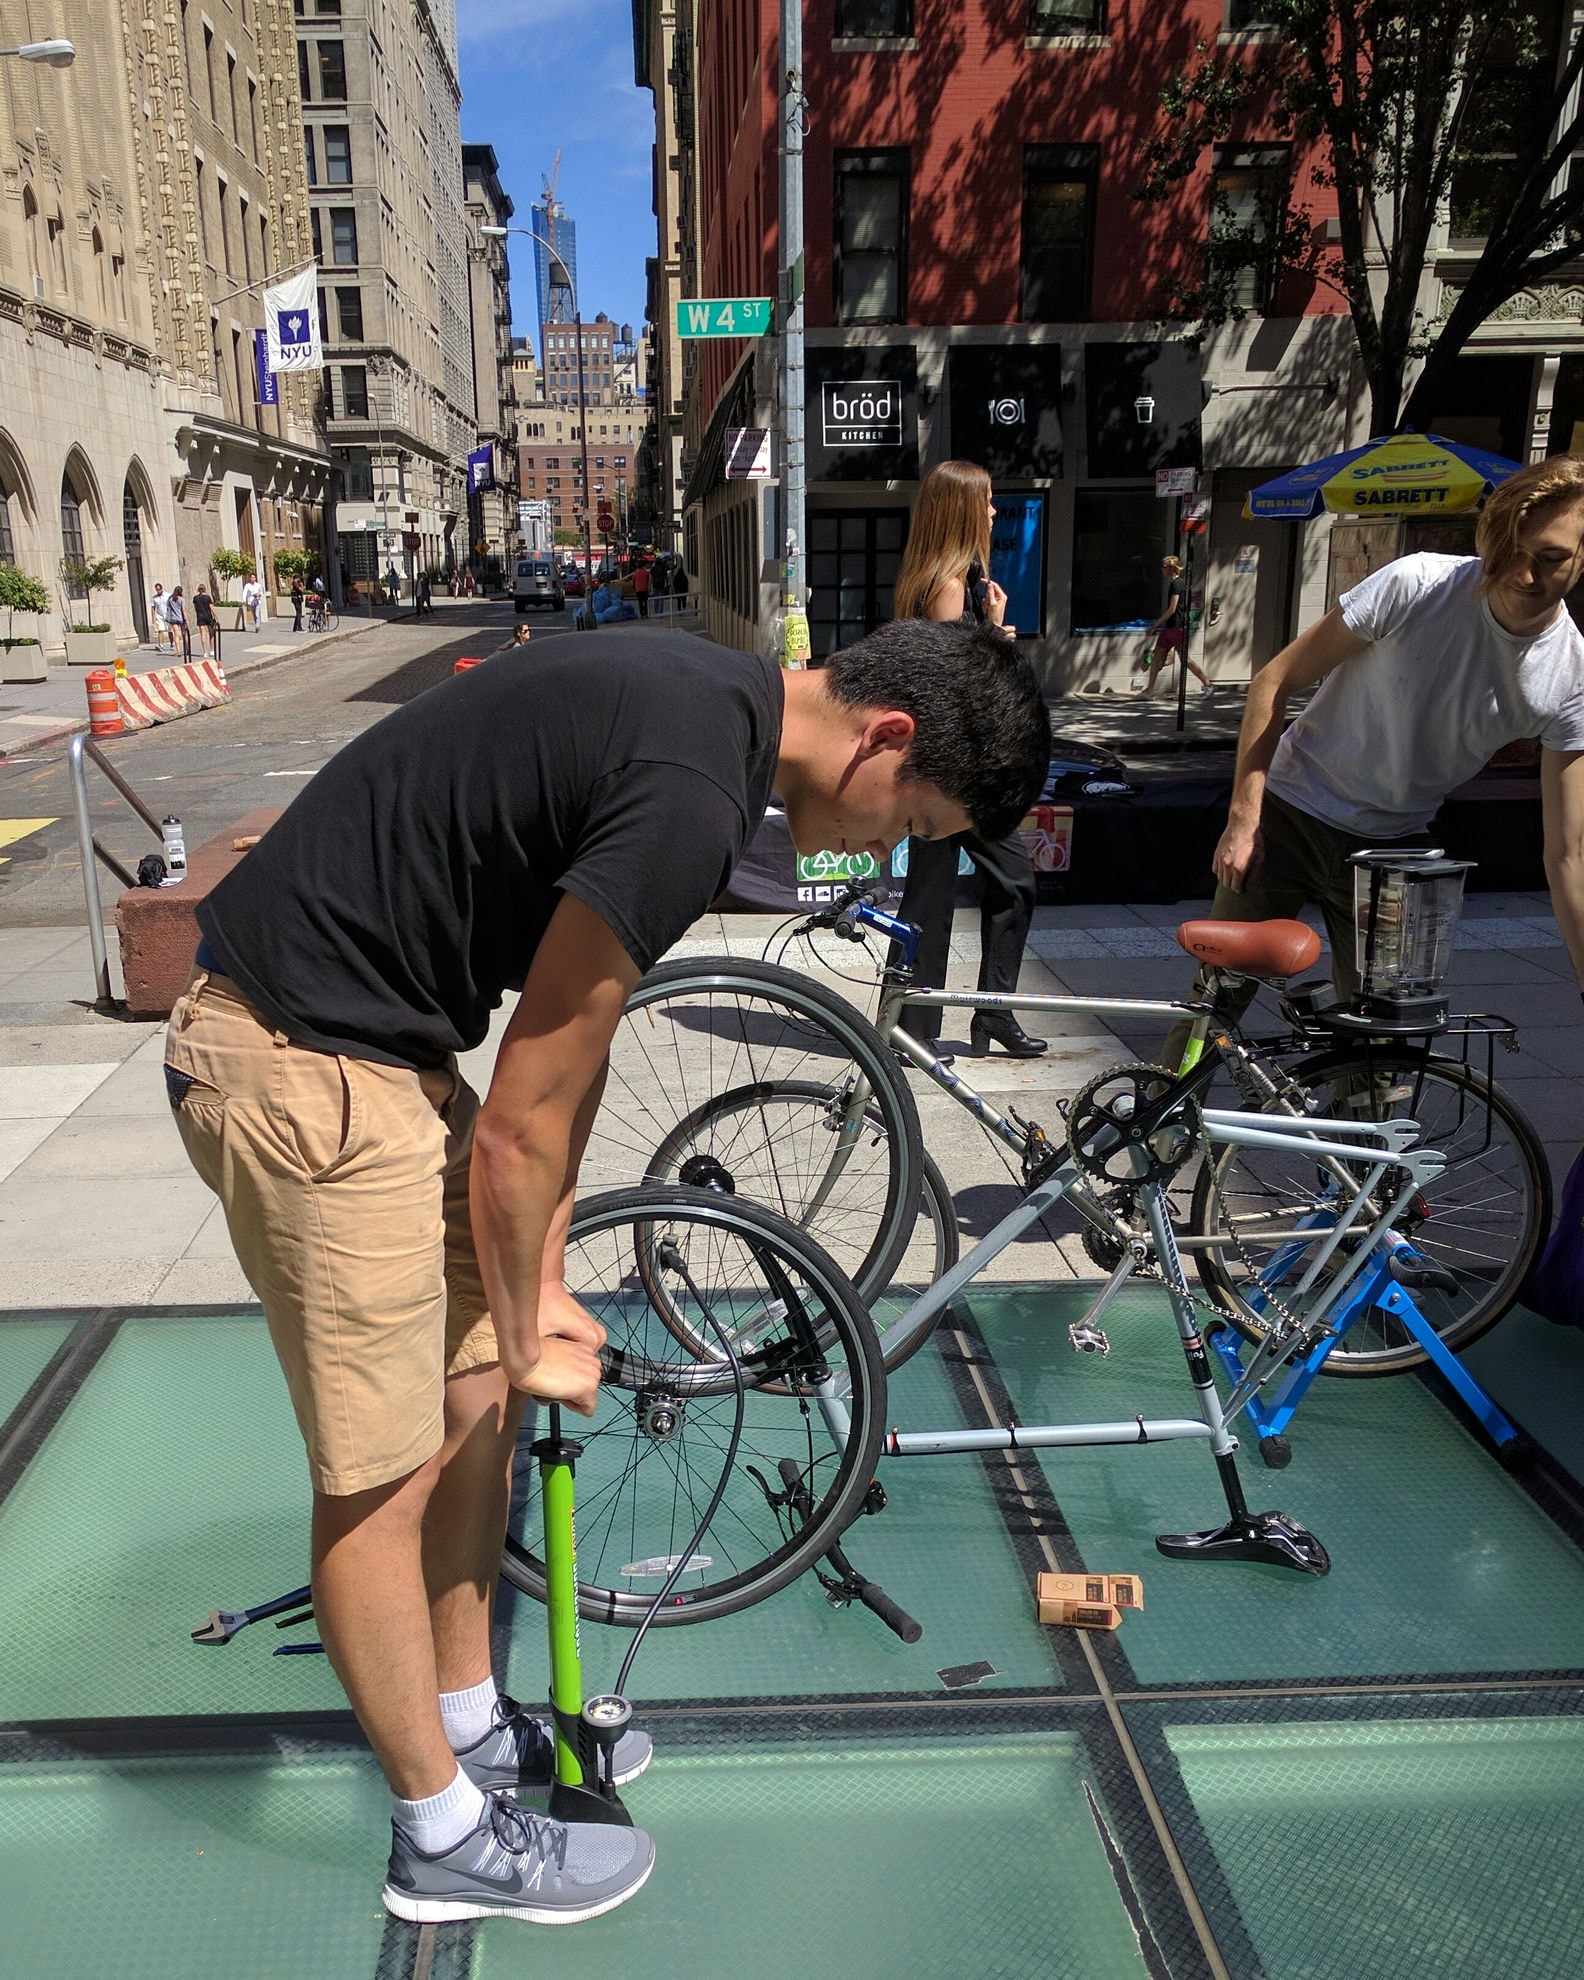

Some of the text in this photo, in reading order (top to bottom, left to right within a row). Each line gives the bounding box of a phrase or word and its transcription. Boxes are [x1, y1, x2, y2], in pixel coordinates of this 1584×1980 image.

[688, 303, 761, 333] W 4 ST
[280, 345, 312, 359] NYU
[832, 390, 891, 420] bröd
[841, 431, 884, 440] KITCHEN
[1353, 459, 1449, 479] SABRETT
[1353, 487, 1449, 505] SABRETT
[599, 519, 613, 528] STOP
[405, 538, 420, 546] STOP
